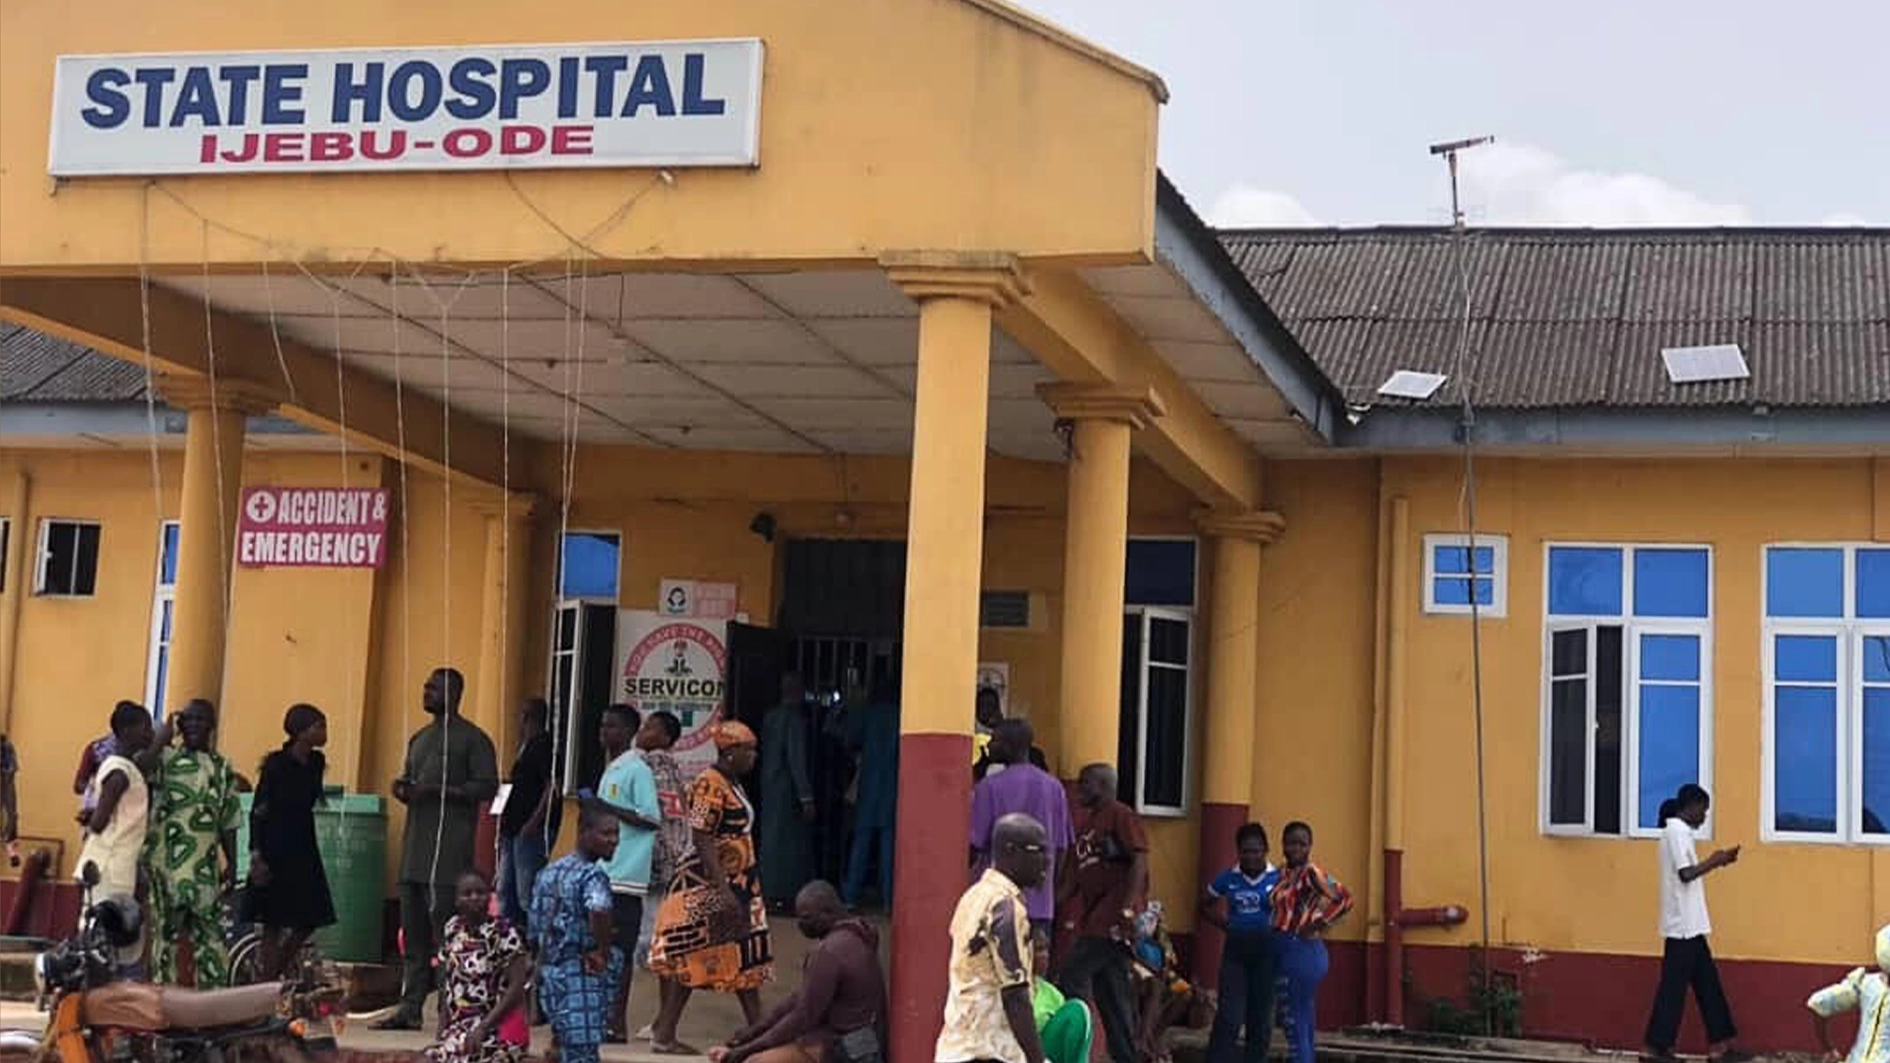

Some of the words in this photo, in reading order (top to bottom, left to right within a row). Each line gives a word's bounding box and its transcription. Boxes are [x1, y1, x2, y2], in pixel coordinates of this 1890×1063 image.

[81, 64, 309, 129] STATE
[332, 53, 725, 123] HOSPITAL
[200, 125, 594, 163] IJEBU-ODE
[277, 491, 370, 524] ACCIDENT
[372, 493, 385, 520] &
[240, 531, 382, 563] EMERGENCY
